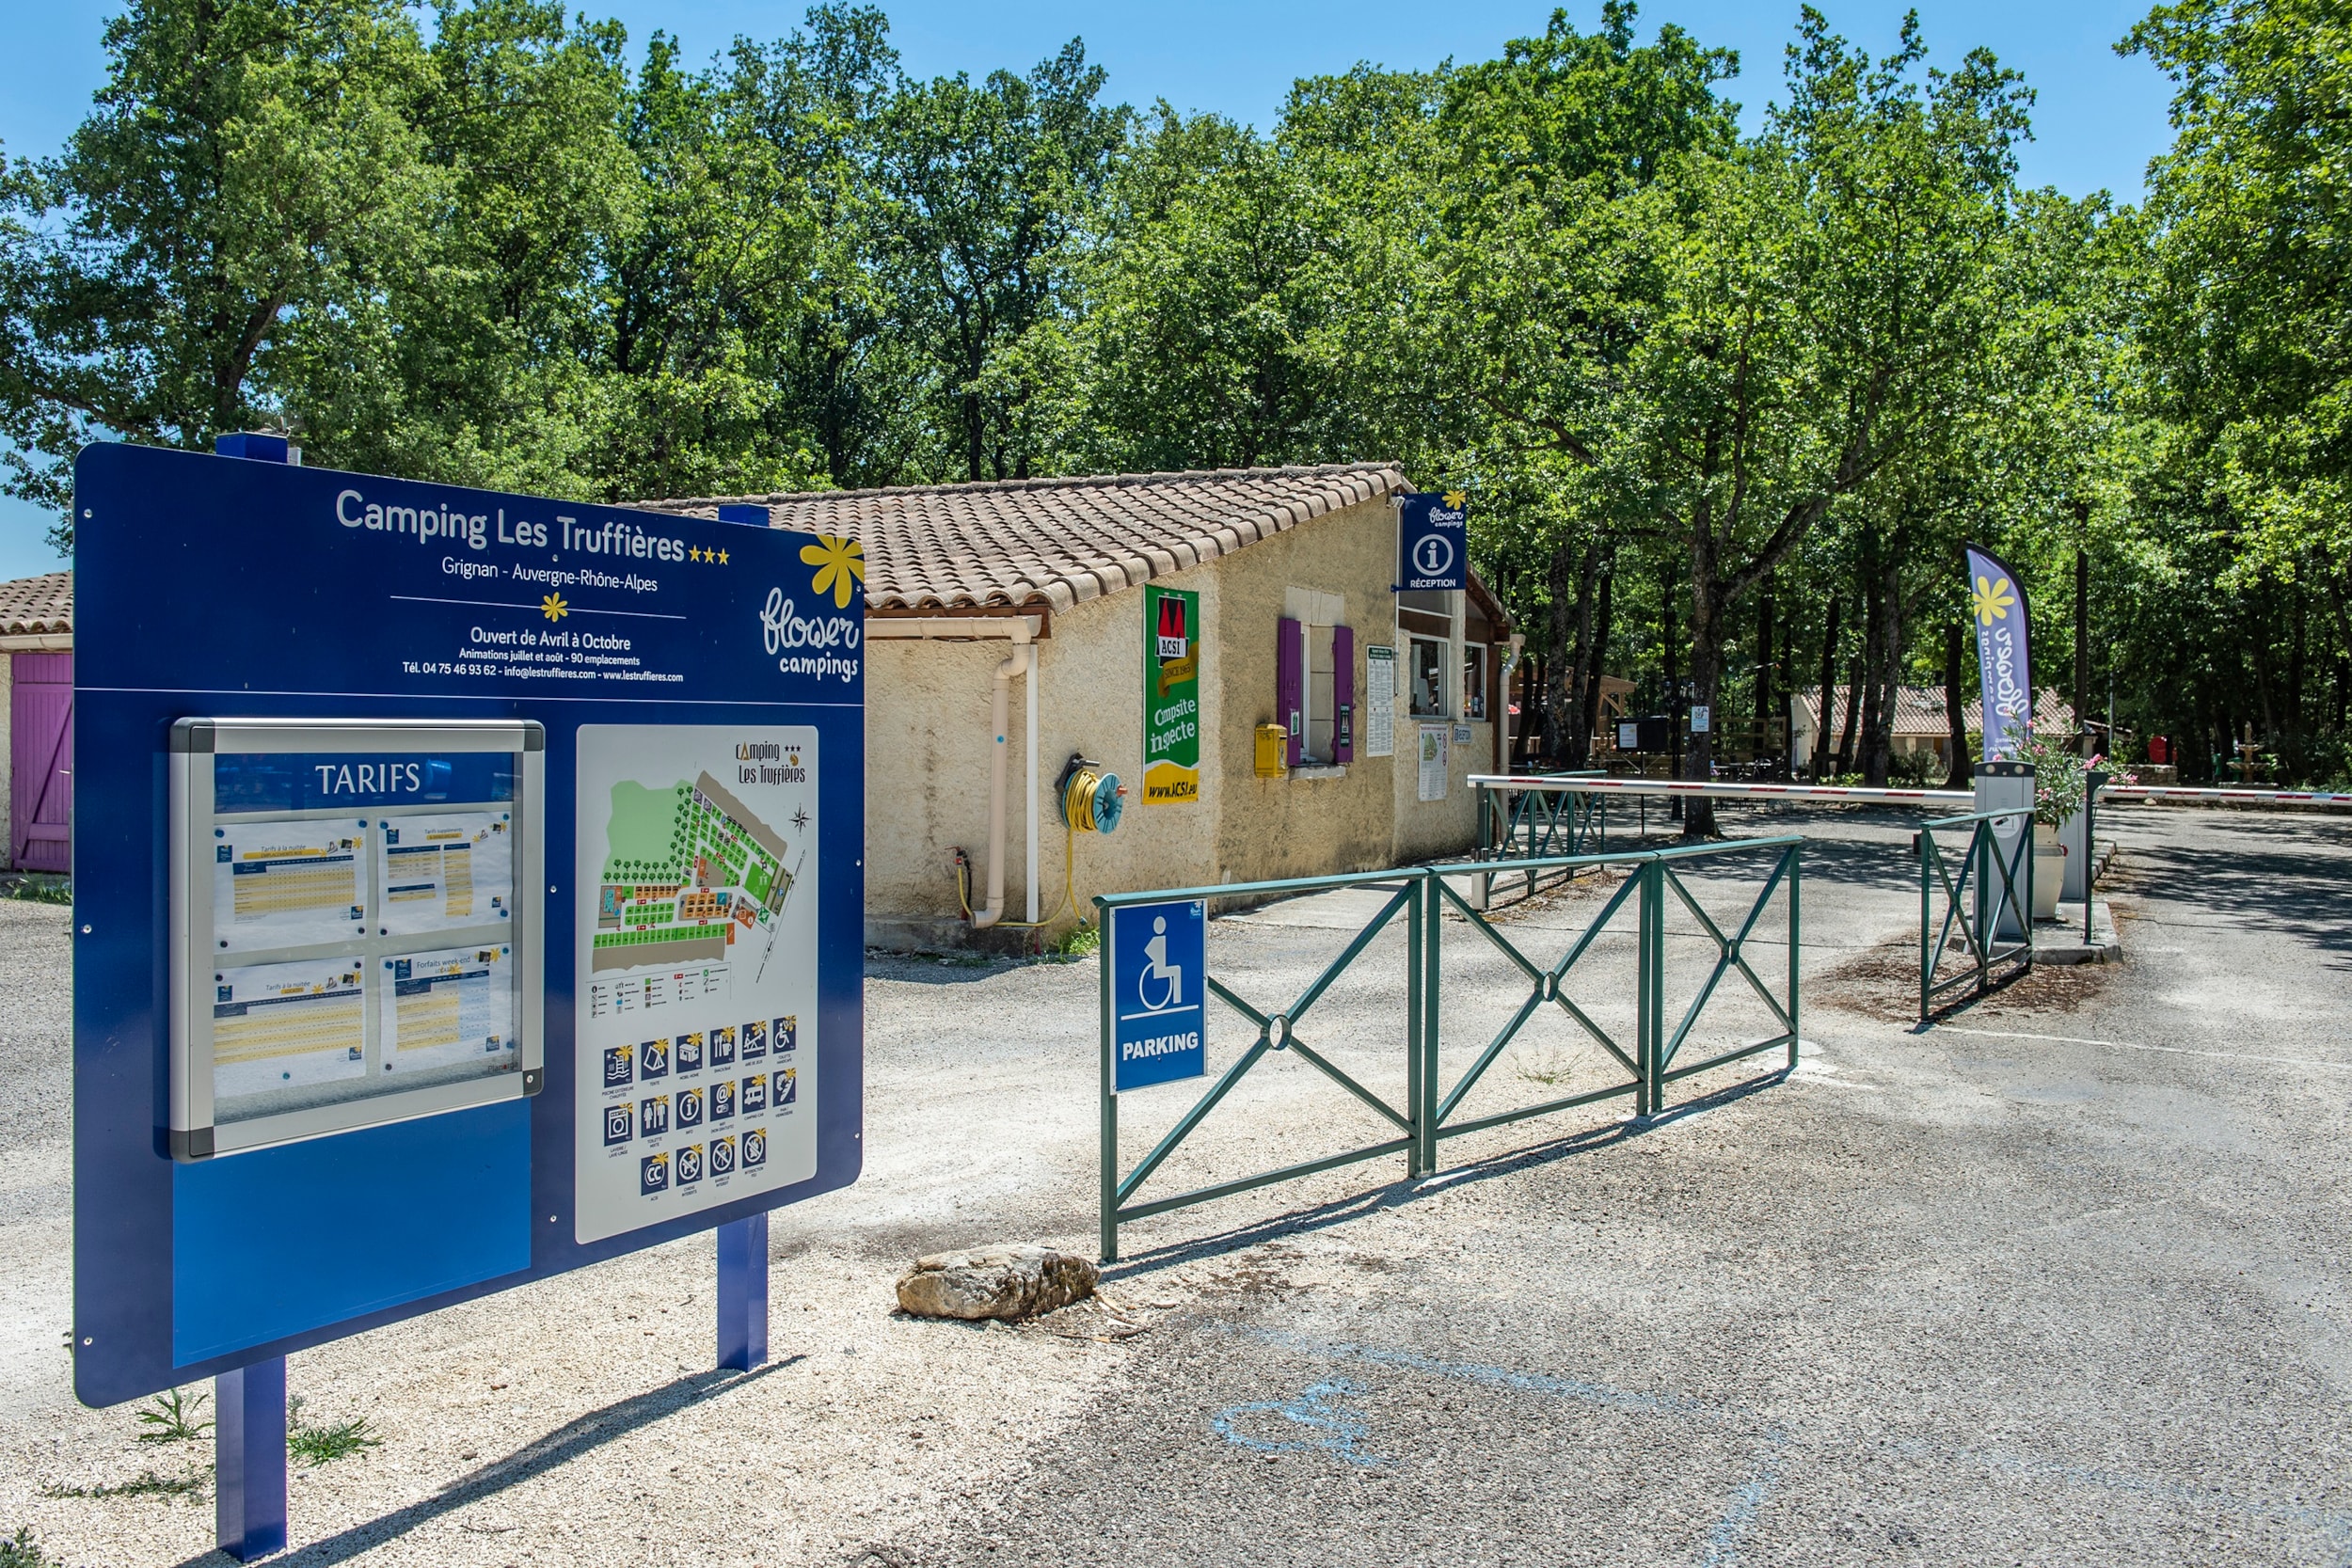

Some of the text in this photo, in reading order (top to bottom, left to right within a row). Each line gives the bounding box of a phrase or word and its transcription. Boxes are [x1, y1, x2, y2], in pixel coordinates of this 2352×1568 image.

[336, 490, 685, 562] Camping Les Truffières
[1428, 507, 1464, 523] flower
[442, 556, 499, 579] Grignan
[512, 563, 659, 593] Auvergne-Rhône-Alpes
[1410, 578, 1456, 588] RÉCEPTION
[759, 587, 860, 655] flower
[470, 626, 631, 651] Ouvert de Avril à Octobre
[1162, 634, 1182, 655] ACSI
[459, 647, 509, 661] Animations
[509, 650, 533, 663] juillet
[535, 653, 544, 662] et
[545, 652, 564, 663] août
[571, 653, 583, 663] 90
[584, 654, 641, 666] emplacements
[780, 651, 858, 683] campings
[403, 661, 421, 674] Tél.
[422, 662, 437, 674] 04
[438, 663, 452, 674] 75
[453, 663, 467, 675] 46
[469, 664, 482, 675] 93
[484, 664, 497, 676] 62
[503, 665, 596, 679] info@lestruffieres.com
[603, 669, 684, 682] www.lestruffieres.com
[315, 763, 421, 796] TARIFS
[739, 765, 805, 786] Les Truffières
[417, 958, 441, 970] Forfaits
[1122, 1031, 1200, 1062] PARKING
